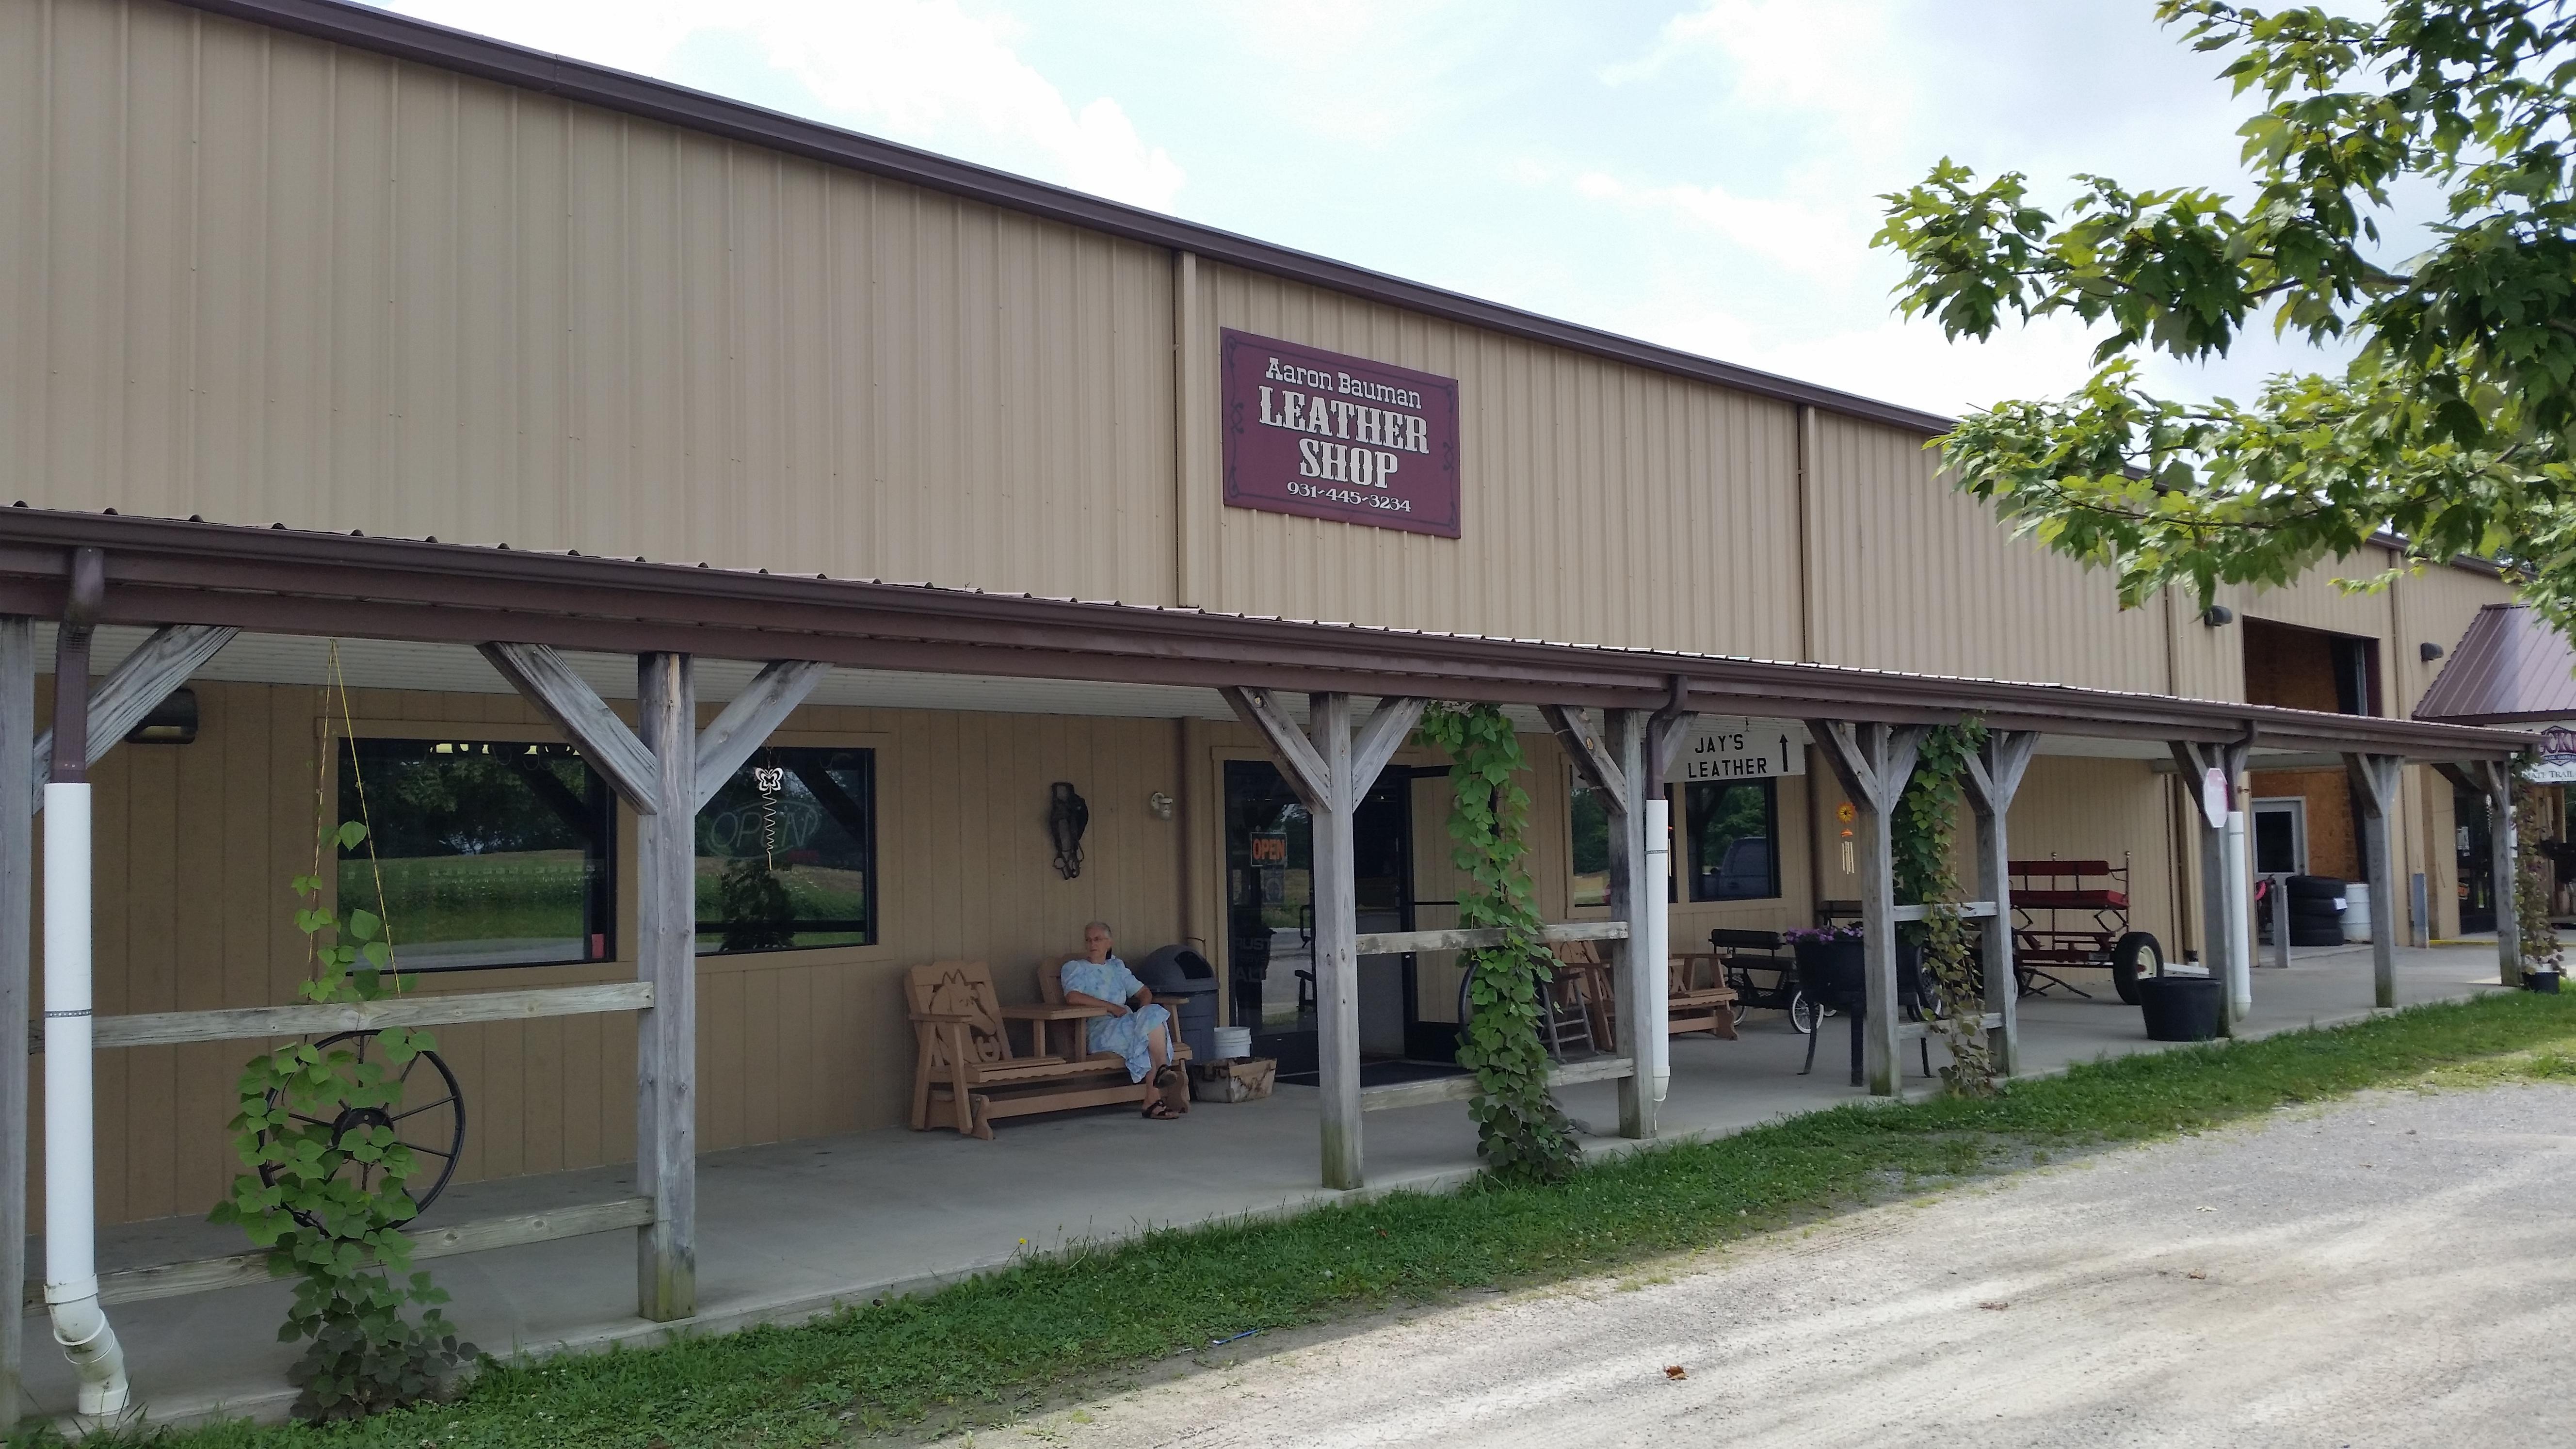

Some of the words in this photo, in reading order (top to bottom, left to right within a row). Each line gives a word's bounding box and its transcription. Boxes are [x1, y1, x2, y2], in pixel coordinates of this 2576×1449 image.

[1266, 357, 1333, 391] Aaron
[1338, 372, 1421, 409] Bauman
[1259, 385, 1429, 454] LEATHER
[1299, 437, 1398, 489] SHOP
[1287, 481, 1412, 512] 931-445-3234
[1695, 734, 1744, 754] JAY'S
[1688, 757, 1767, 778] LEATHER
[2549, 770, 2574, 778] TRAIL
[710, 811, 810, 848] OPEN
[1253, 838, 1285, 860] OPEN
